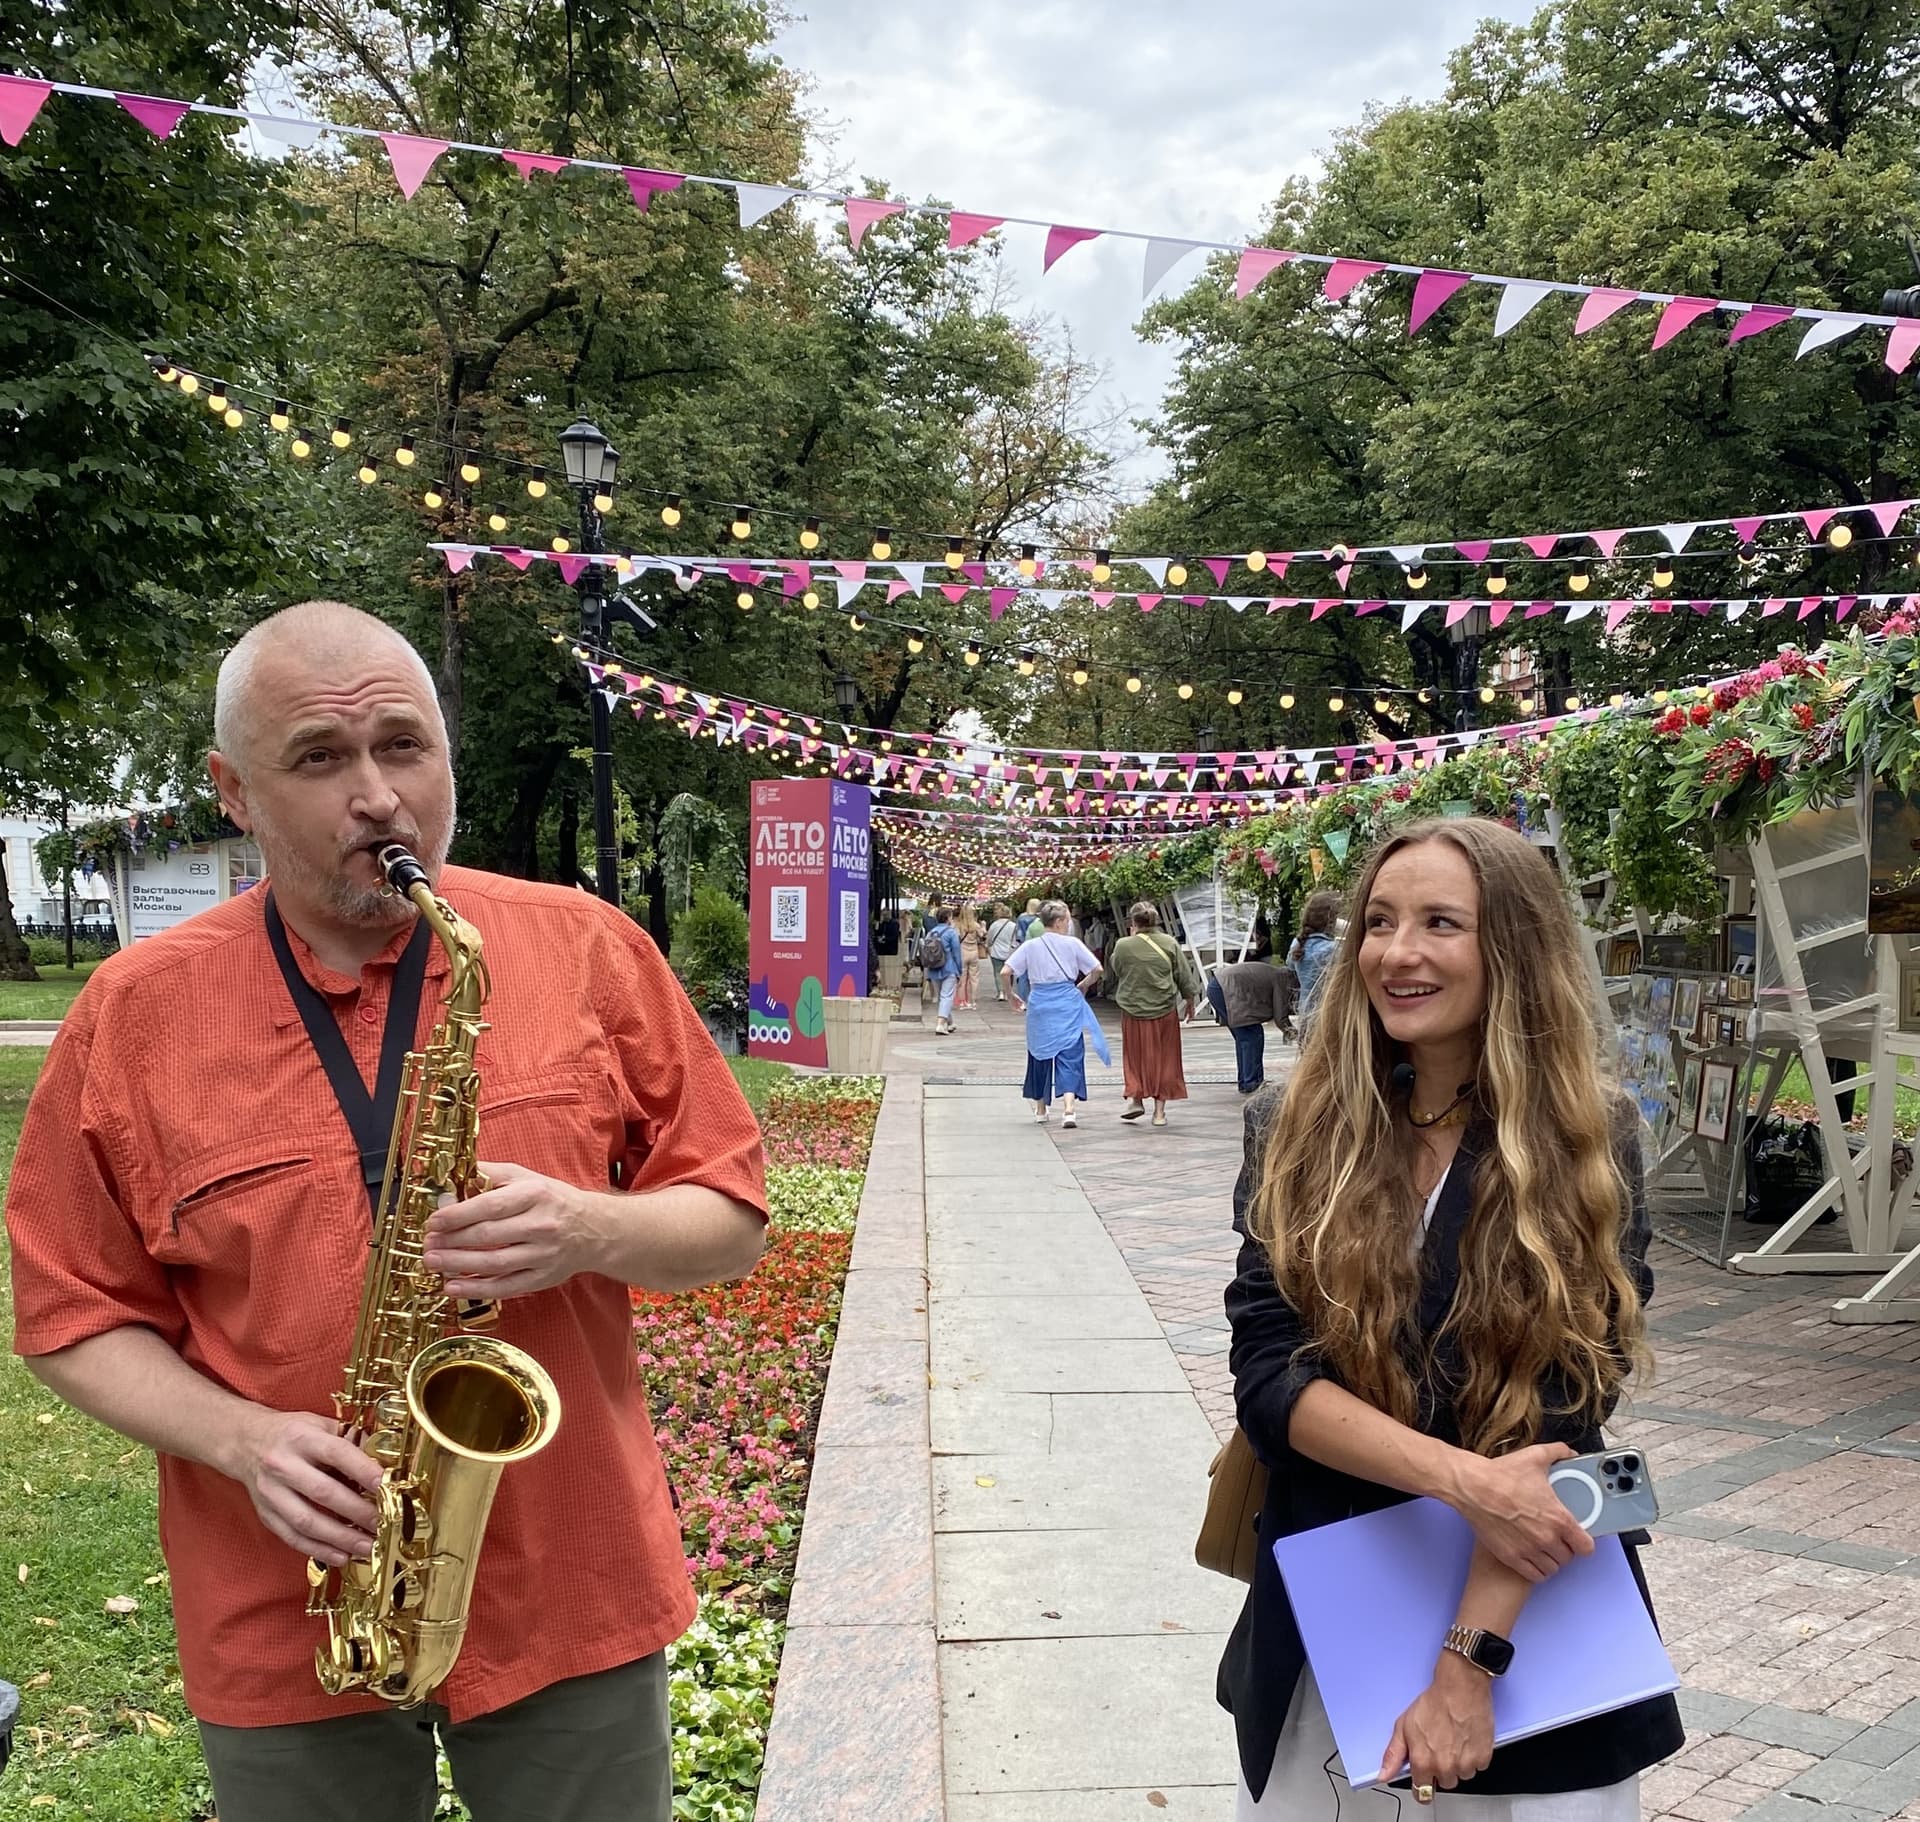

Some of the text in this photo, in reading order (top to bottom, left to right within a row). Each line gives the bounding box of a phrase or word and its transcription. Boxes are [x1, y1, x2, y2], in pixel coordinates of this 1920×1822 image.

[756, 821, 825, 850] ЛЕТО
[832, 823, 869, 856] ЛЕТО
[755, 851, 825, 867] В МОСКВЕ
[832, 853, 868, 872] В МОСКВЕ
[133, 885, 217, 896] Выставочные
[133, 902, 183, 911] Москвы
